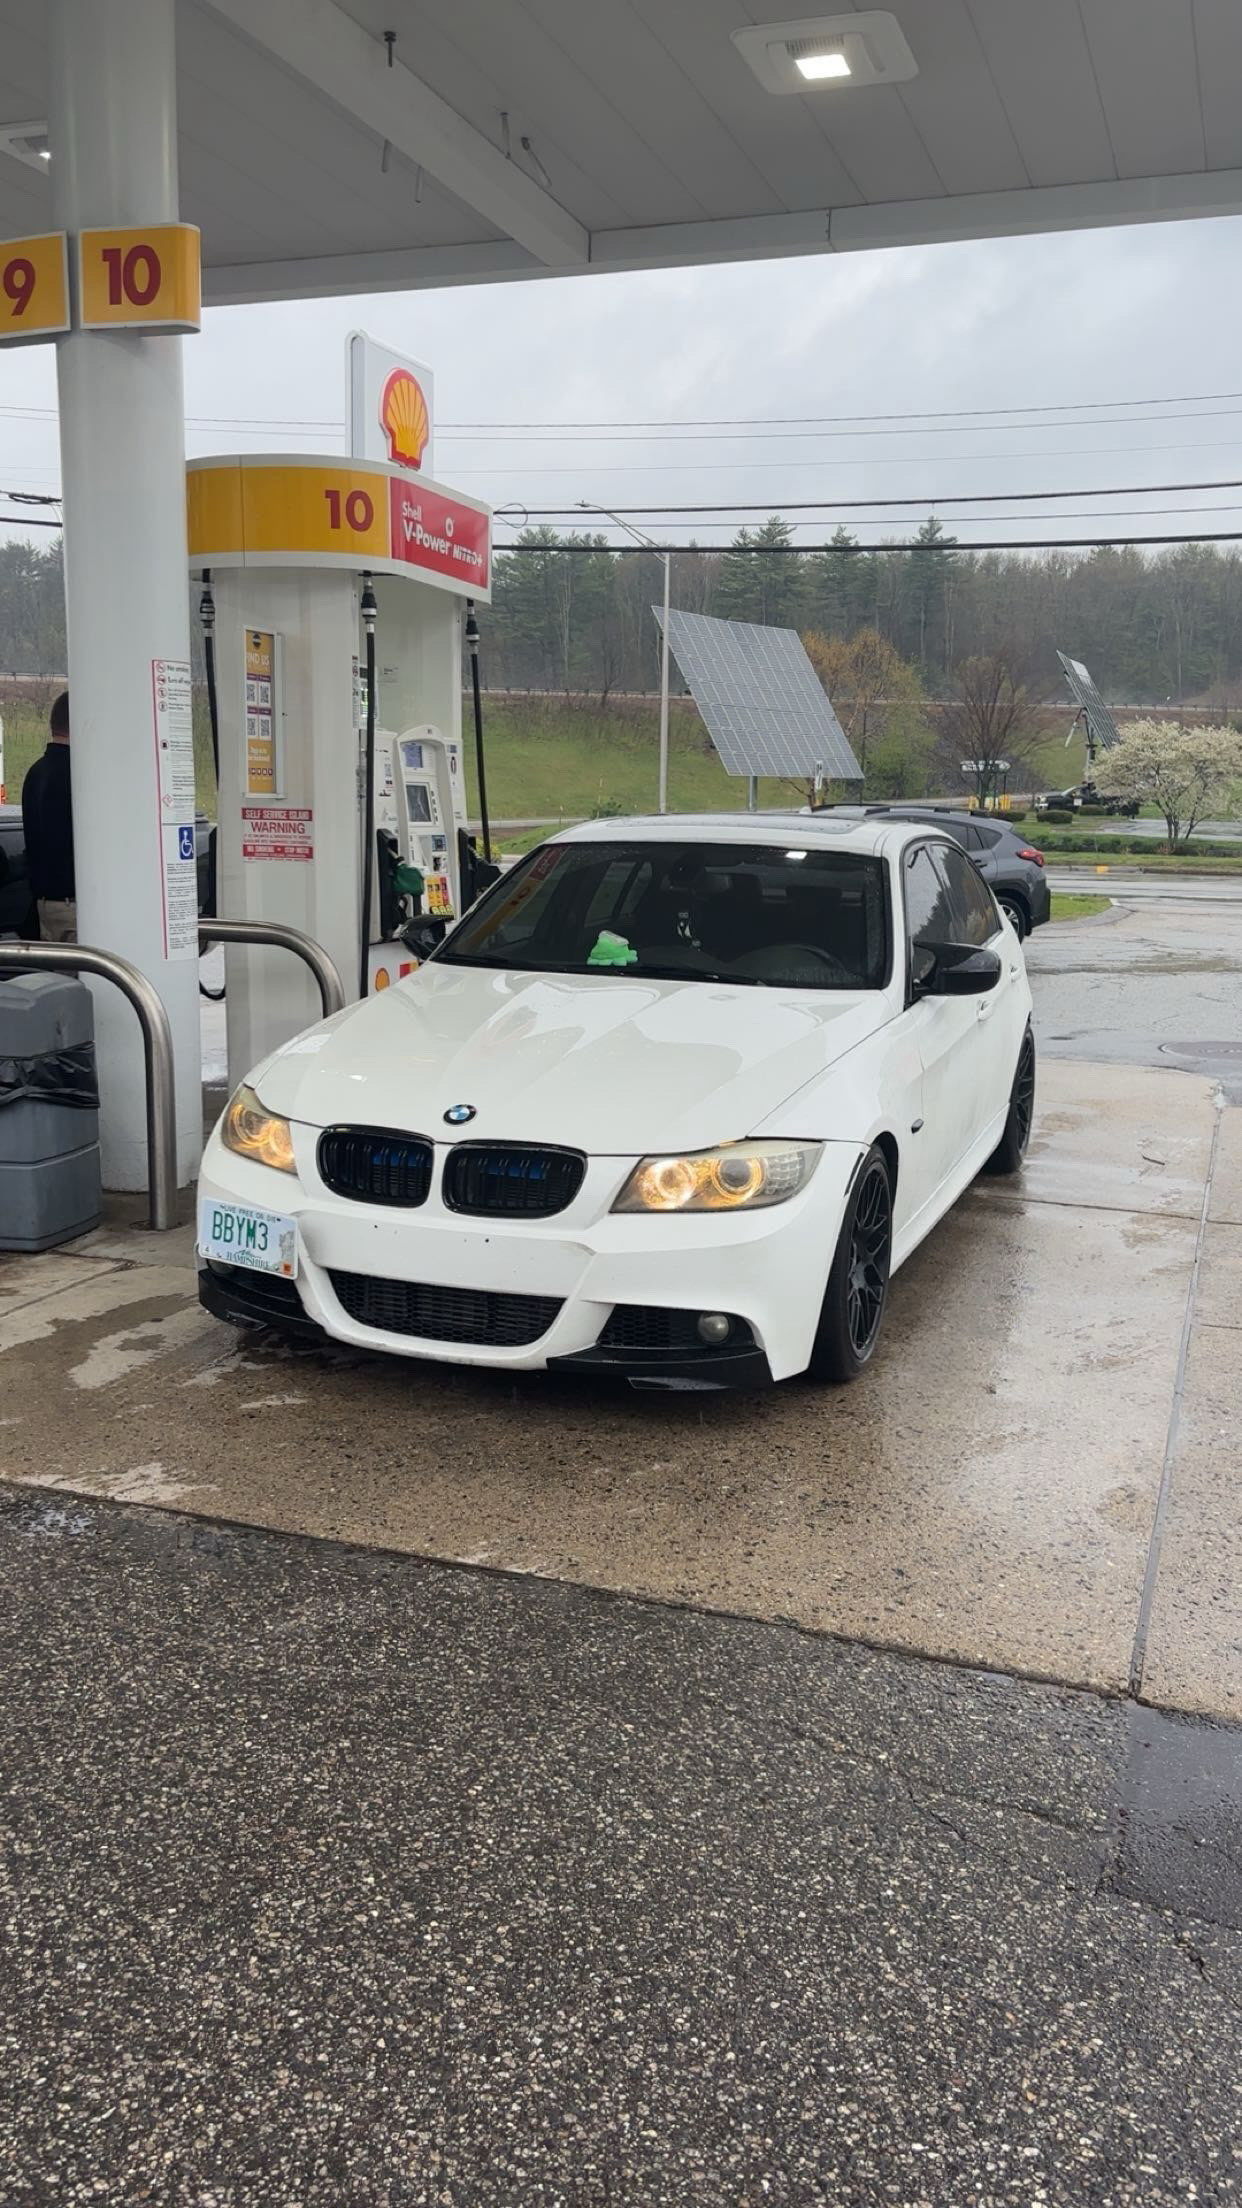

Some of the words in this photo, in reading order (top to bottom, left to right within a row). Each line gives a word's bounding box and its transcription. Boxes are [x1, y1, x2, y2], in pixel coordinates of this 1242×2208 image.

[3, 258, 36, 316] 9
[102, 244, 161, 306] 10
[325, 489, 374, 532] 10
[402, 501, 422, 521] Shell
[403, 519, 449, 555] V-Power
[245, 809, 261, 819] SELF
[251, 821, 306, 834] WARNING
[212, 1210, 268, 1251] BBYM3
